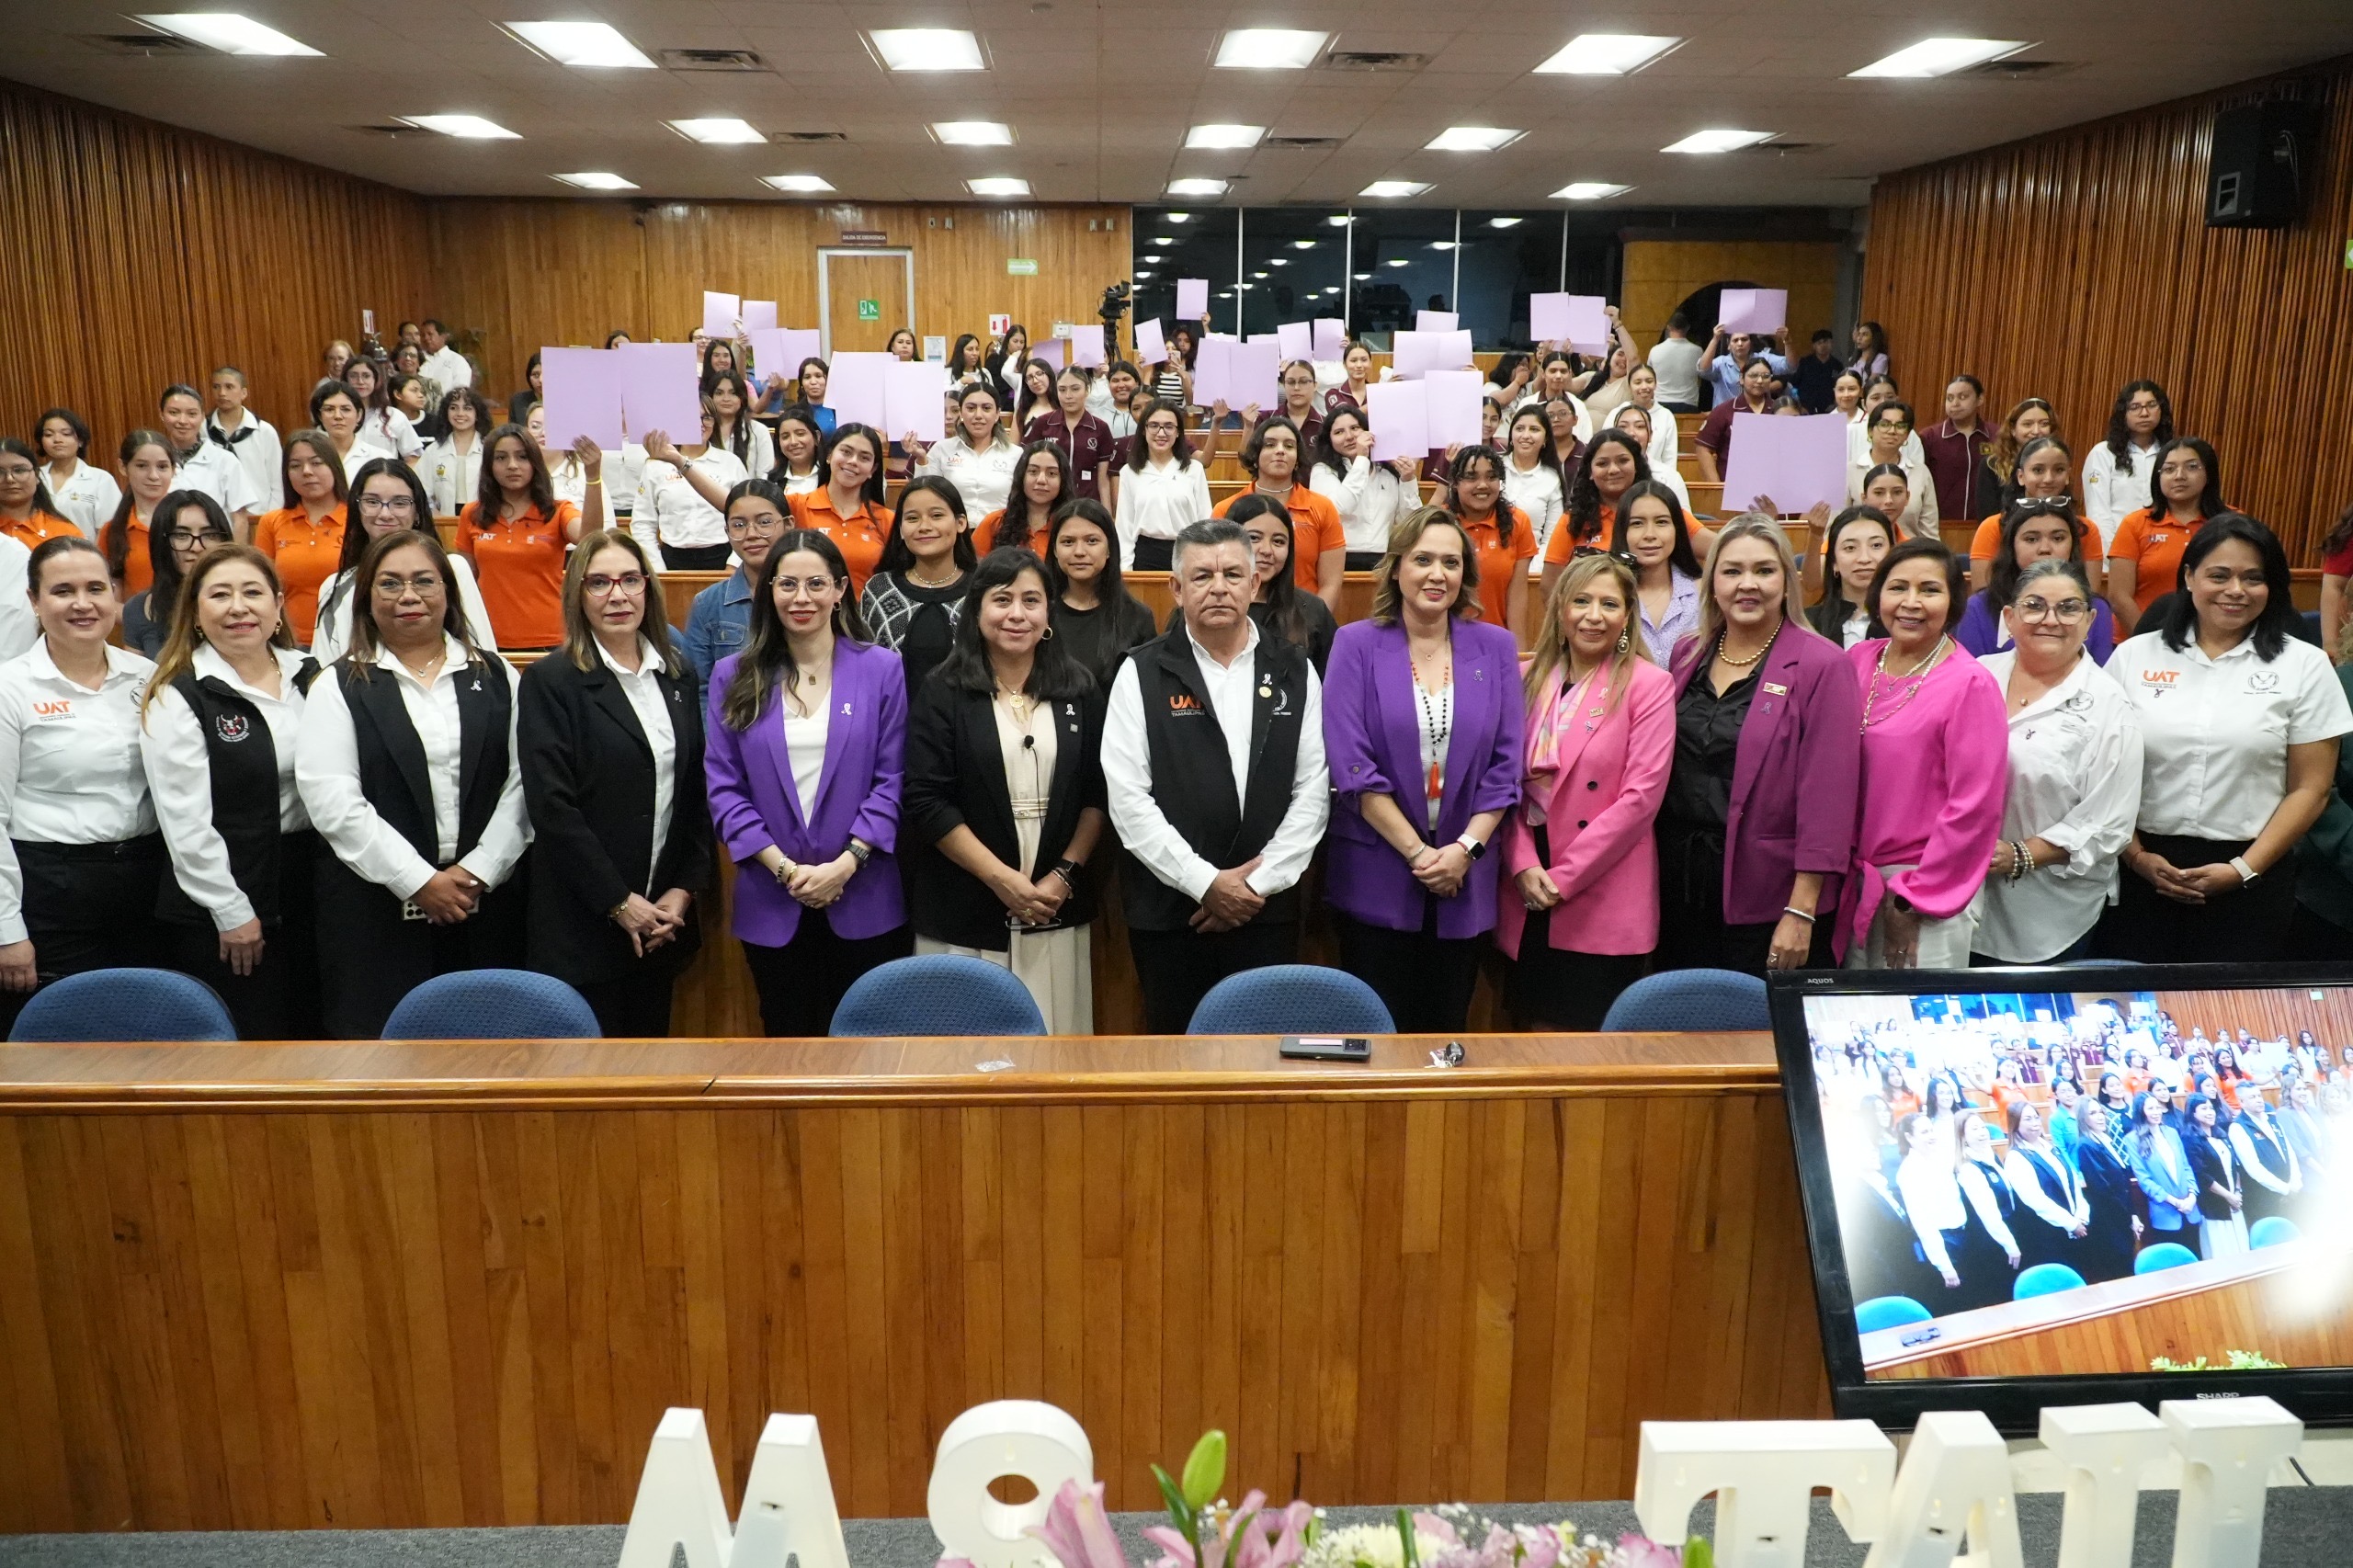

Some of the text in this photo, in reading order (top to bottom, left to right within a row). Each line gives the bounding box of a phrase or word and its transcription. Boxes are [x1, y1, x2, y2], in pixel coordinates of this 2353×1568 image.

[2143, 670, 2181, 683] UAT
[33, 700, 70, 714] UAT
[1807, 977, 1835, 985] AQUOS
[2196, 1392, 2240, 1400] SHARP
